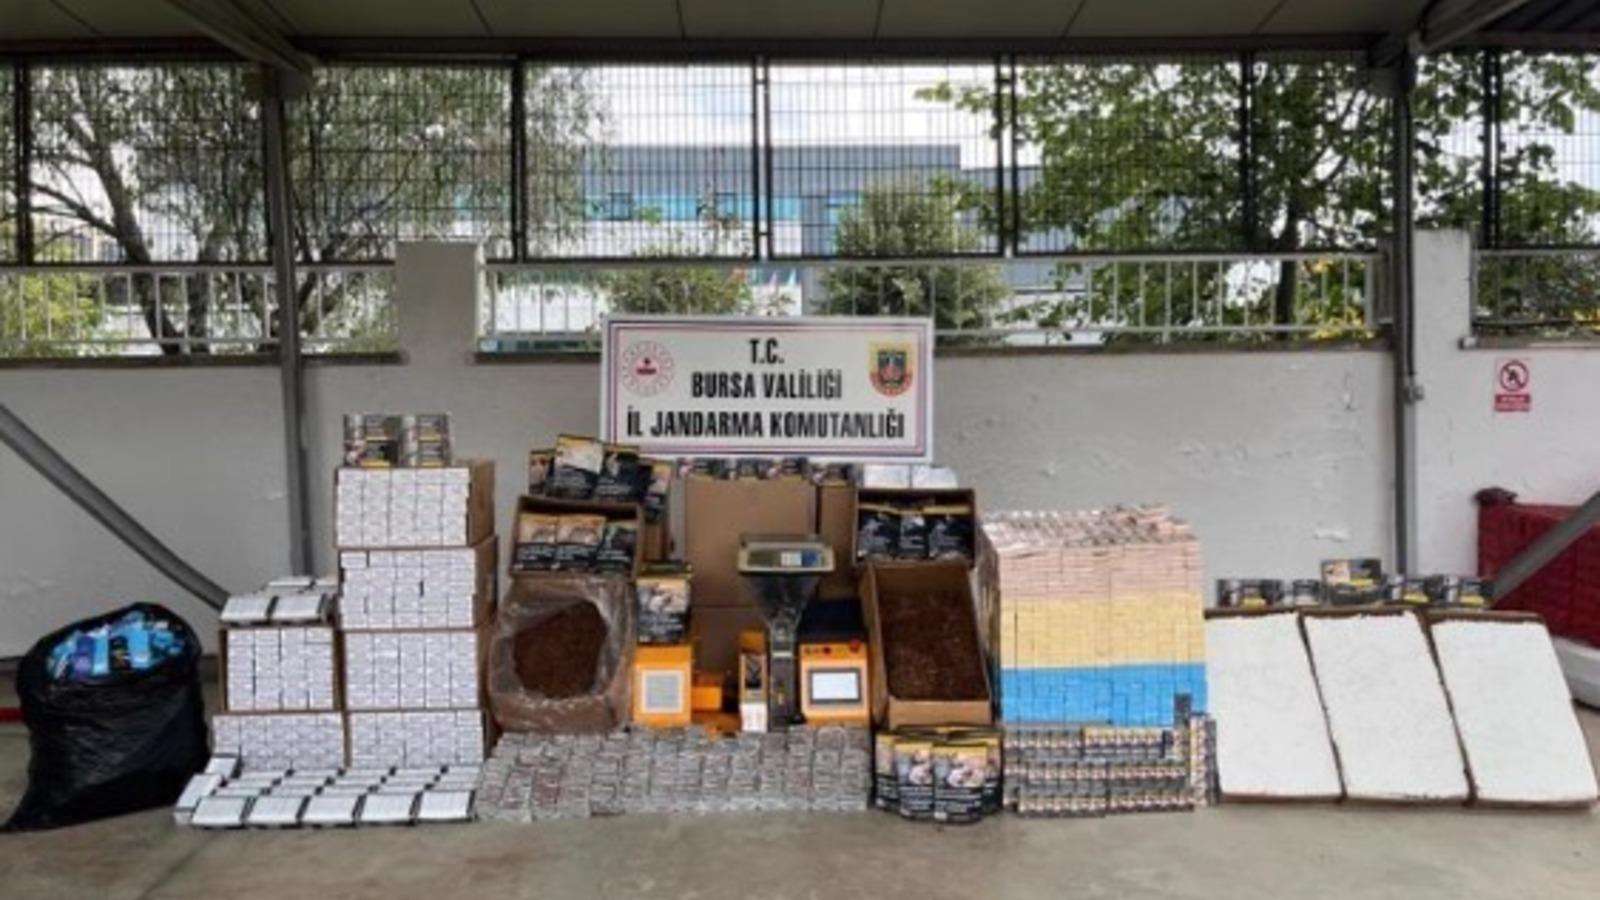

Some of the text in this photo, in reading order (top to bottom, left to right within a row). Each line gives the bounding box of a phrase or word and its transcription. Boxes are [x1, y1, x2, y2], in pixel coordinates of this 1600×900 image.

[749, 338, 785, 364] T.C.
[691, 368, 842, 400] BURSA VALİLİĞİ
[626, 405, 905, 439] İL JANDARMA KOMUTANLIĞI
